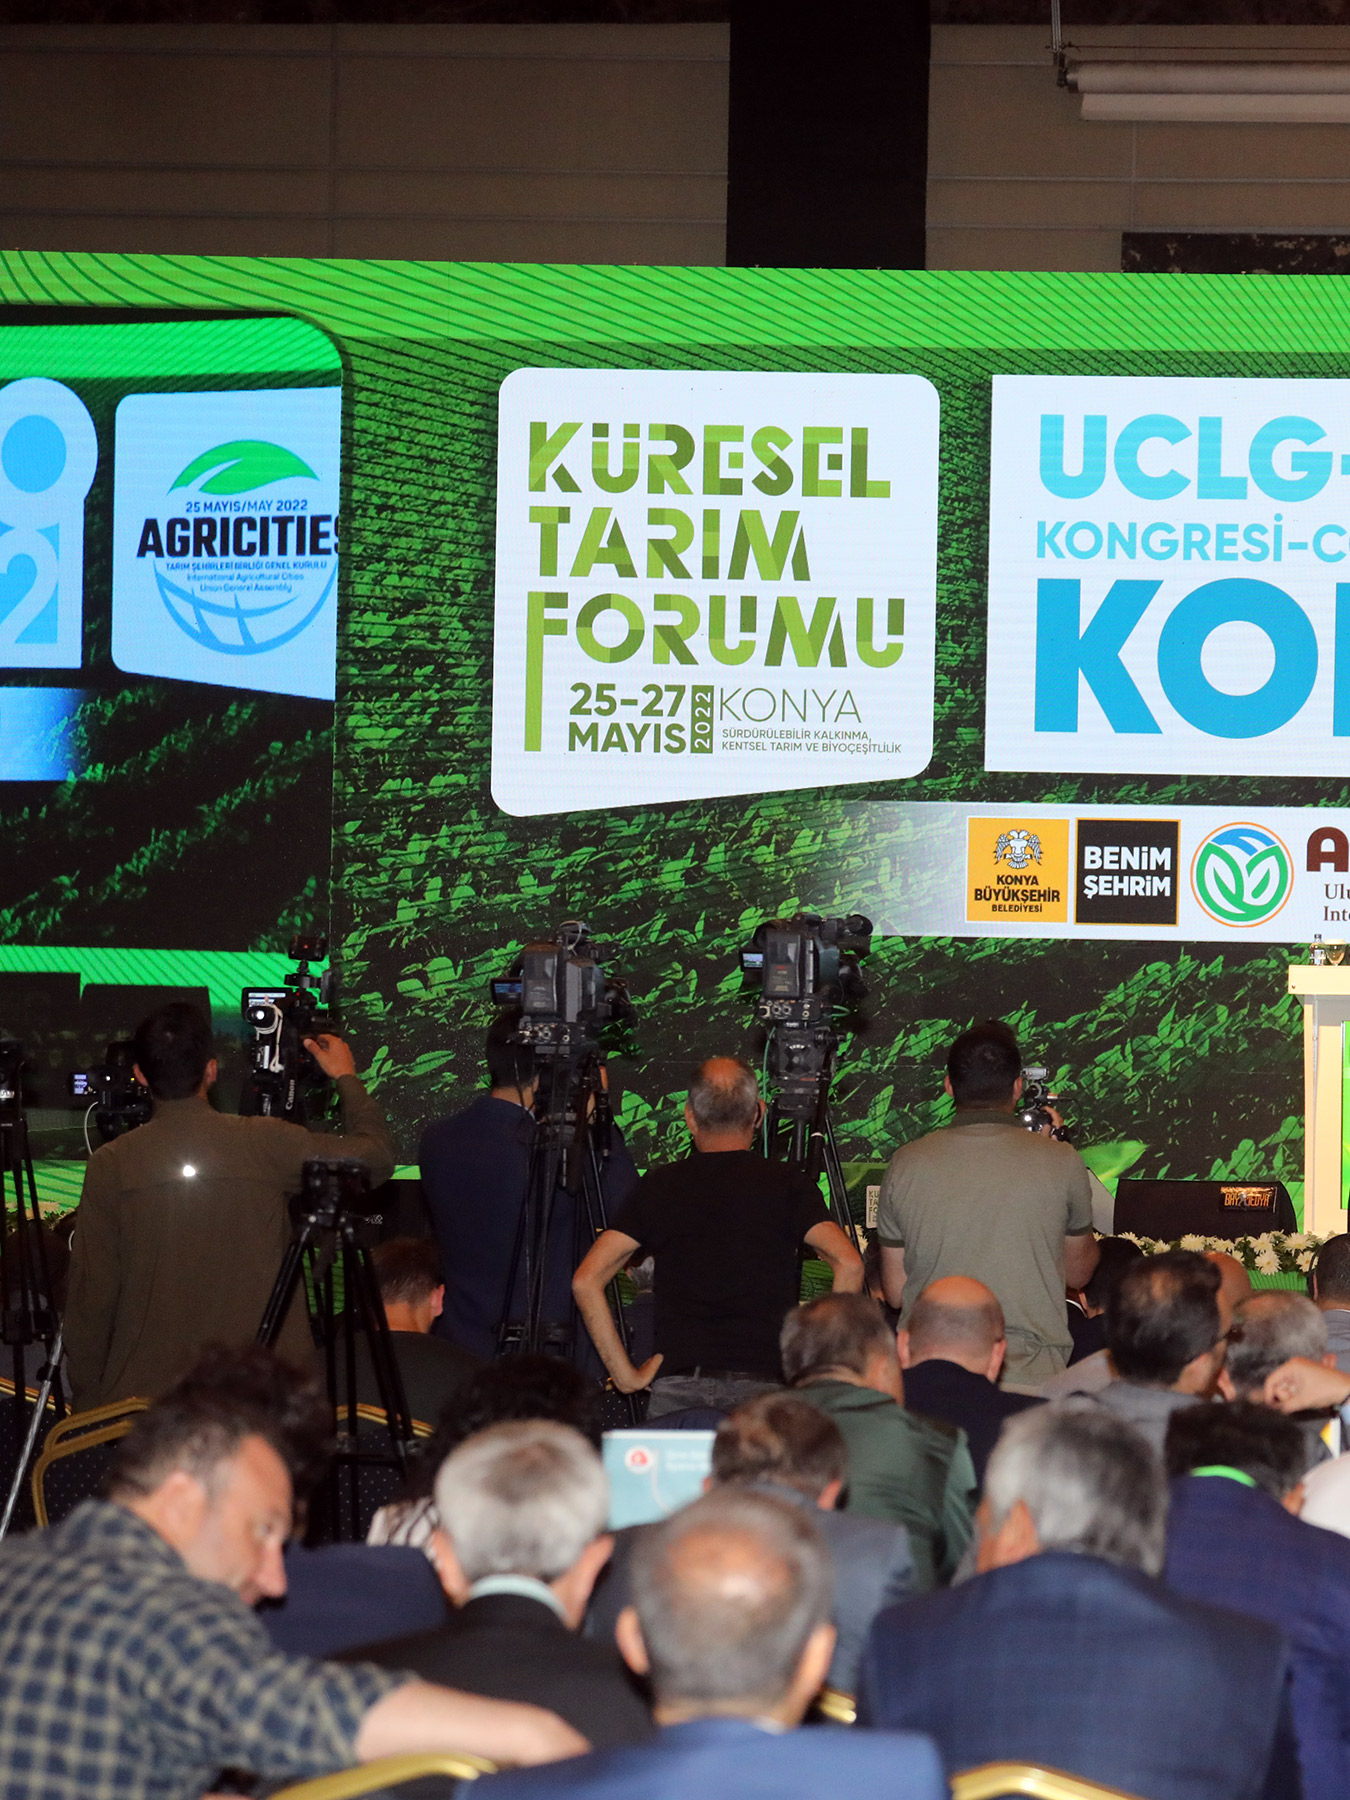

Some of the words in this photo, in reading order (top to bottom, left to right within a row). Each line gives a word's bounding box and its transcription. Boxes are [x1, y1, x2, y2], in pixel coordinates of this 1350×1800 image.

[528, 421, 891, 498] KÜRESEL
[186, 502, 201, 513] 25
[203, 500, 274, 513] MAYIS/MAY
[276, 499, 308, 512] 2022
[136, 515, 339, 558] AGRICITIE
[529, 506, 811, 582] TARIM
[569, 682, 686, 717] 25-27
[719, 687, 862, 724] KONYA
[568, 721, 687, 754] MAYIS
[694, 691, 712, 750] 2022
[721, 741, 768, 752] KENTSEL
[770, 741, 803, 752] TARIM
[804, 741, 819, 752] VE
[974, 886, 1060, 903] BÜYÜKŞEHİR
[996, 874, 1039, 886] KONYA
[285, 1079, 296, 1111] Canon
